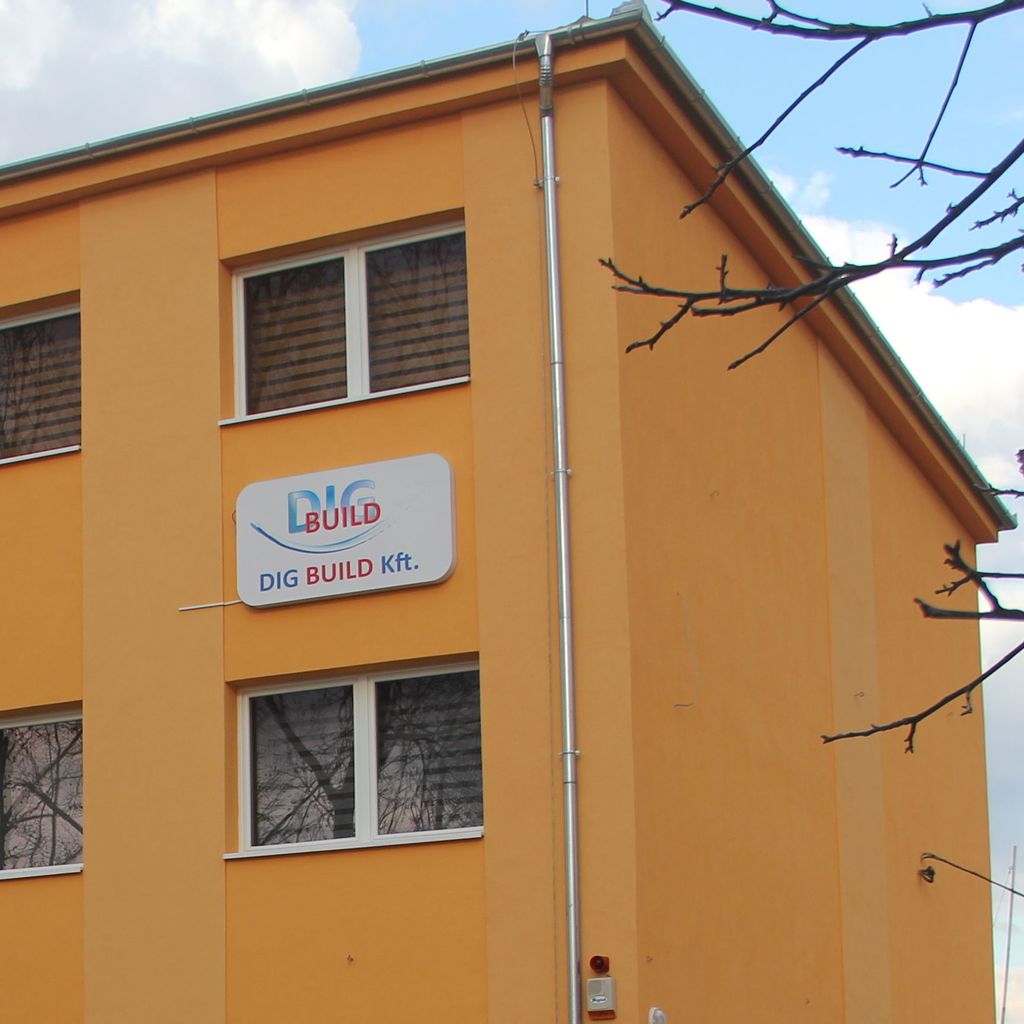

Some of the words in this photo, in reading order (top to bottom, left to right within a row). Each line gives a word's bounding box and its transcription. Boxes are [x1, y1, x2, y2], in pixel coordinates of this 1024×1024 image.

[288, 479, 375, 533] DIG
[305, 502, 381, 533] BUILD
[260, 569, 298, 591] DIG
[306, 558, 373, 585] BUILD
[381, 552, 419, 574] Kft.
